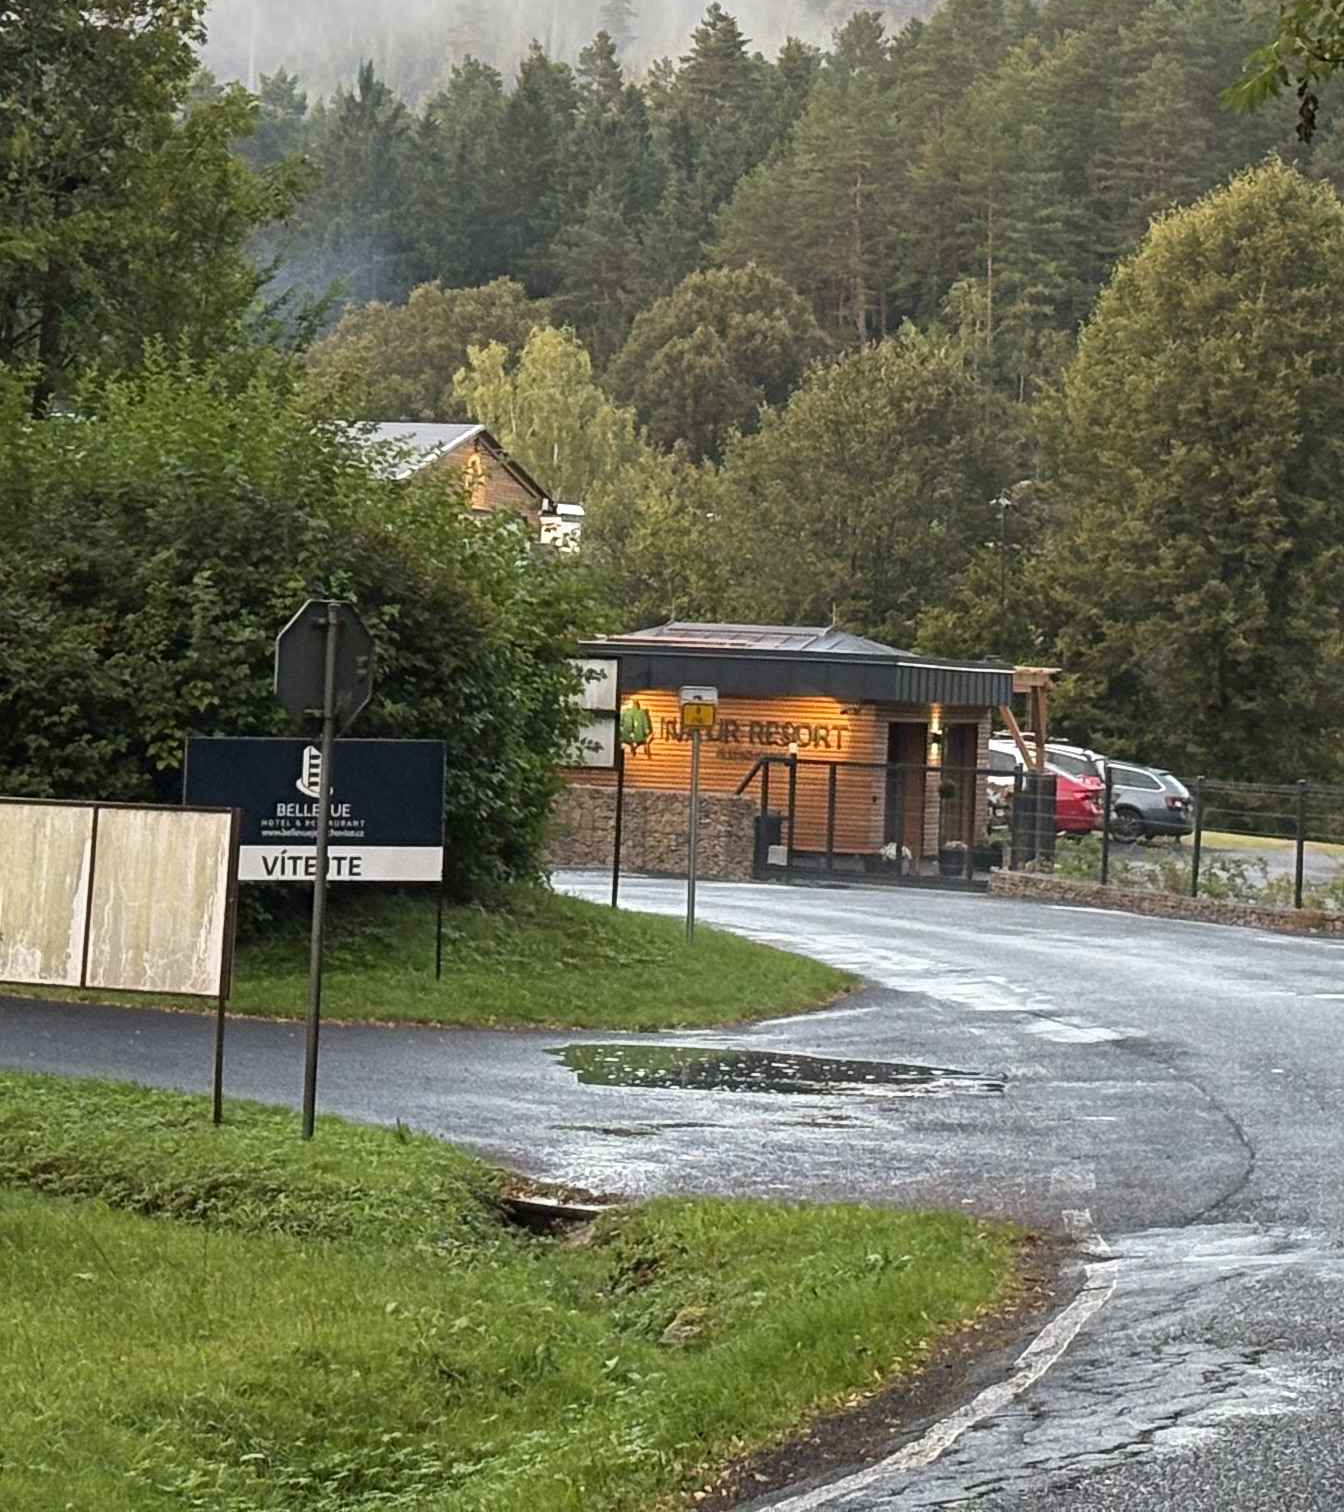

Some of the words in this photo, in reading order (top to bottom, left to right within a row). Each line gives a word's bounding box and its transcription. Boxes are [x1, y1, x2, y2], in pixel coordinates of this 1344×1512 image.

[749, 720, 850, 749] RESORT
[277, 803, 351, 817] BELLEUE
[261, 819, 291, 827] HOTEL
[305, 819, 365, 828] REAURANT
